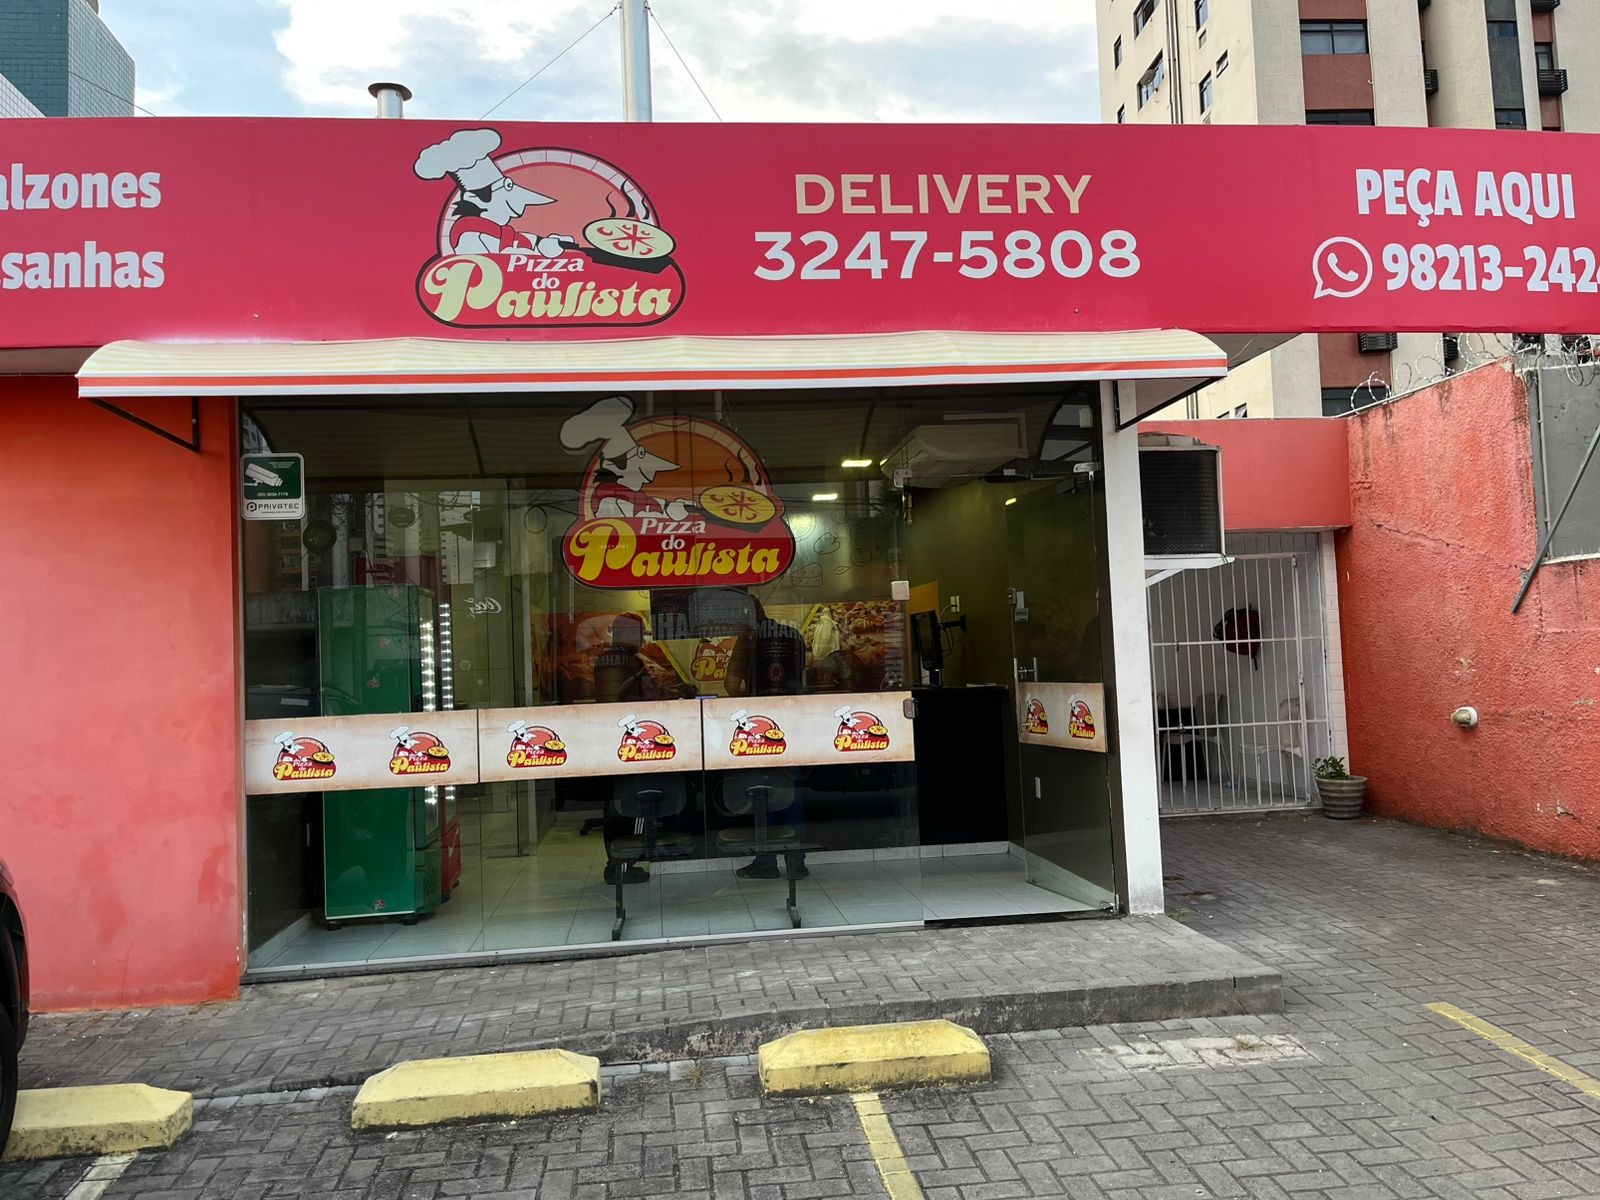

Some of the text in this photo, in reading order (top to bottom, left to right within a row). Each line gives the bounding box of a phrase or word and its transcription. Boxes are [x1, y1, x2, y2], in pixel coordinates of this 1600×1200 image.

[794, 173, 1092, 214] DELIVERY
[1355, 168, 1575, 227] PEÇA AQUI
[753, 229, 1141, 280] 3247-5808
[0, 241, 165, 289] sanhas
[507, 254, 584, 273] Pizza
[1382, 243, 1600, 293] 98213-242
[424, 254, 672, 322] Paulista
[531, 273, 560, 289] do
[640, 518, 706, 535] Pizza
[570, 518, 780, 581] Paulista
[661, 534, 686, 550] do
[731, 739, 784, 756] Paulista
[834, 735, 887, 751] Paulista
[507, 750, 565, 767] Paulista
[619, 745, 674, 761] Paulista
[273, 762, 334, 779] Paulista
[391, 757, 448, 774] Paulista
